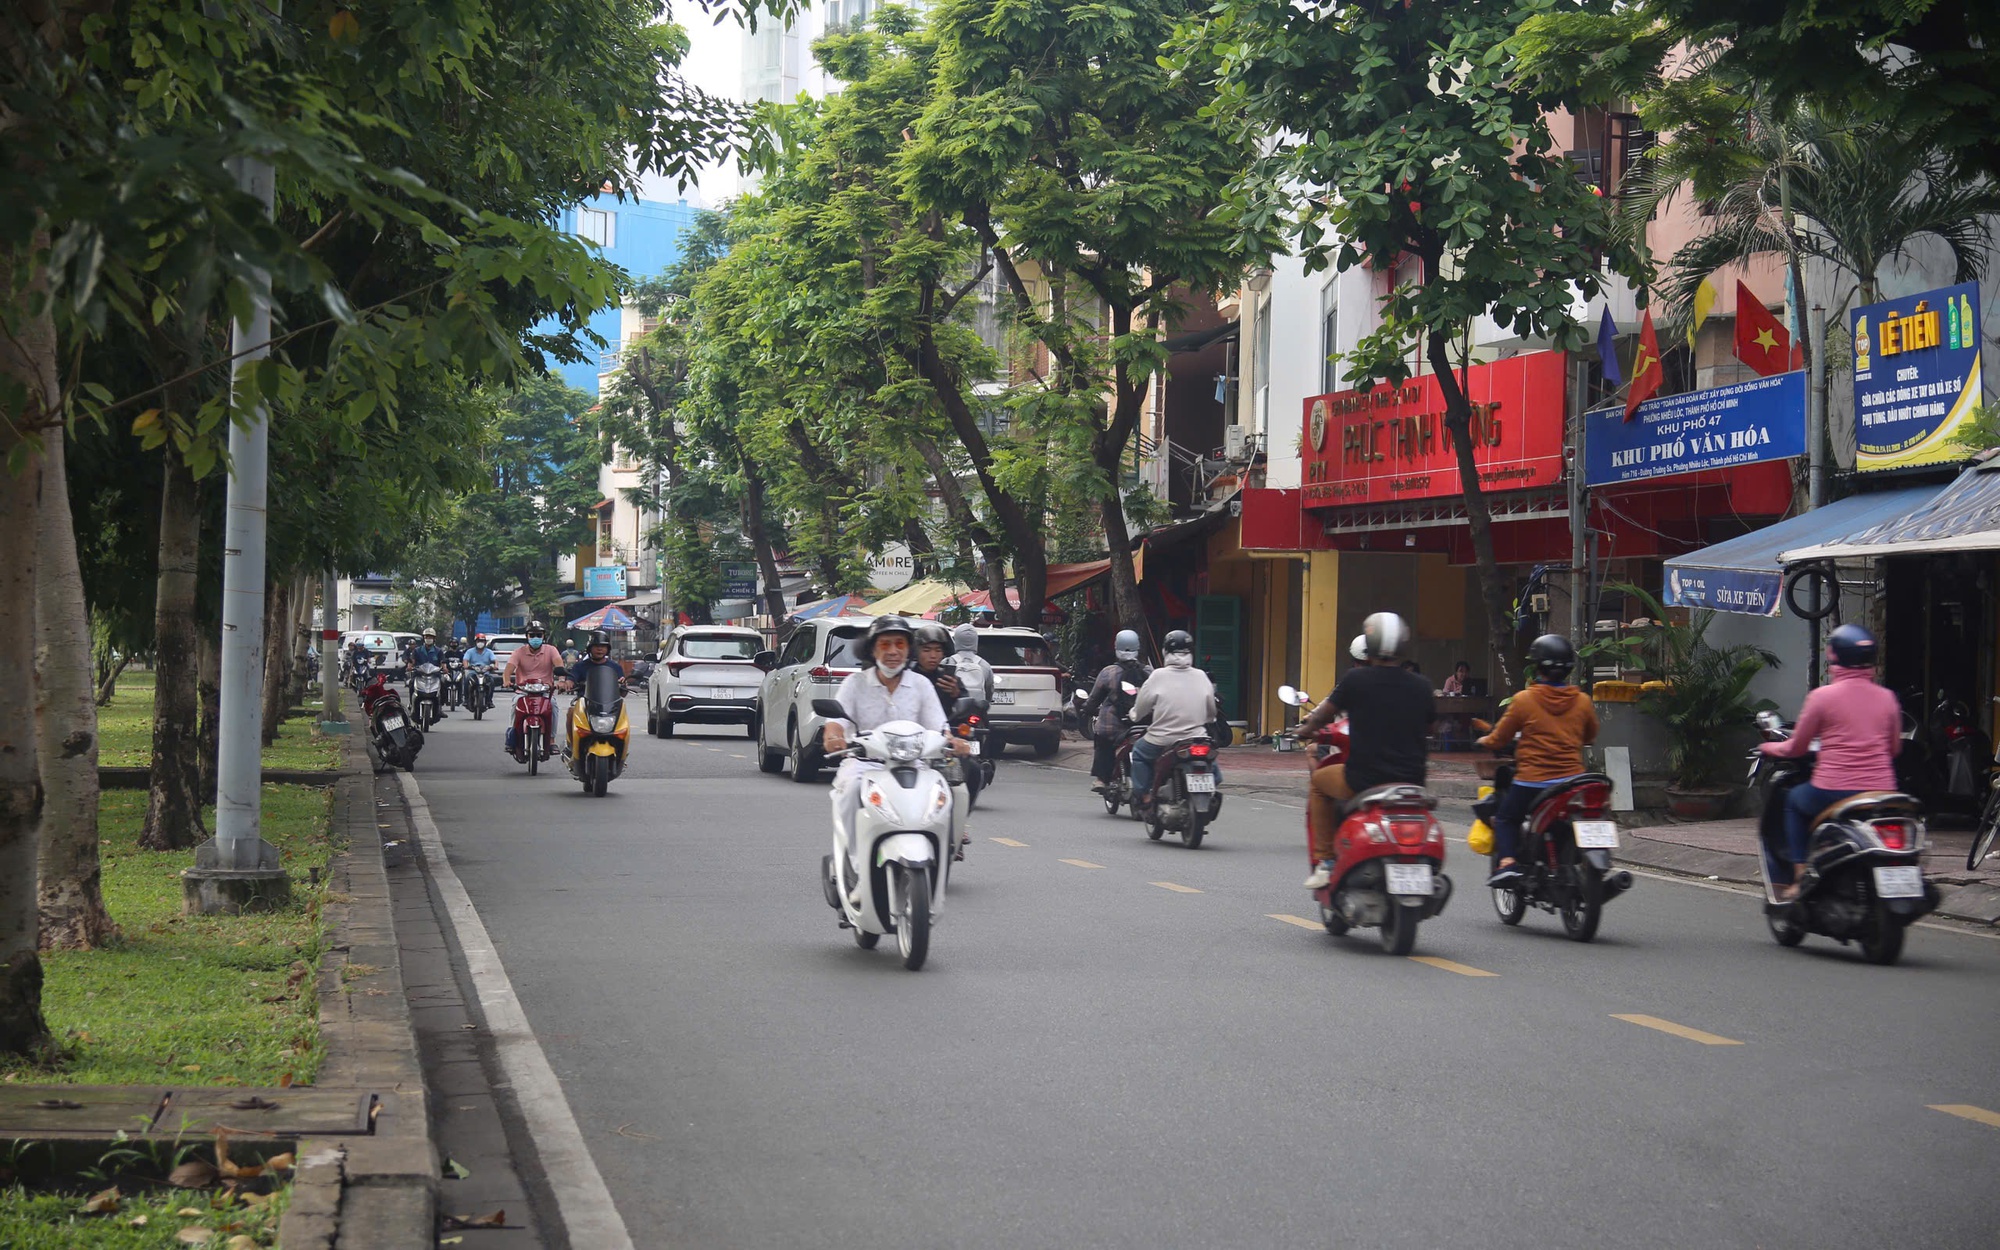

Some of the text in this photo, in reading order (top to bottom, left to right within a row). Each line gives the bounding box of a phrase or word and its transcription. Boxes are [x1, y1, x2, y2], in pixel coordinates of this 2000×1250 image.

[1879, 300, 1940, 356] LÊ TIẾN
[1857, 338, 1869, 351] TOP
[1648, 401, 1660, 410] TRÀO
[1675, 396, 1686, 405] DÂN
[1686, 394, 1698, 403] ĐOÀN
[1699, 390, 1709, 400] KẾT
[1709, 389, 1719, 399] XÂY
[1720, 386, 1734, 397] DỰNG
[1744, 381, 1758, 392] SỐNG
[1758, 379, 1770, 390] VĂN
[1911, 386, 1919, 399] XE
[1928, 382, 1936, 397] GA
[1936, 379, 1945, 395] VÀ
[1945, 380, 1953, 394] XE
[1953, 375, 1961, 392] SỐ
[1685, 404, 1700, 416] THÀNH
[1700, 401, 1709, 413] PHỐ
[1717, 398, 1725, 410] CHÍ
[1726, 398, 1738, 408] MINH
[1657, 413, 1722, 435] KHU PHỐ 47
[1611, 424, 1771, 468] KHU PHỐ VĂN HÓA
[1710, 457, 1724, 466] Thành
[1739, 452, 1747, 462] Chí
[1748, 451, 1759, 460] Minh
[1682, 579, 1692, 588] TOP
[1697, 580, 1705, 589] OIL
[1716, 585, 1732, 603] SỬA
[1732, 590, 1744, 605] XE
[1745, 587, 1765, 606] TIẾN
